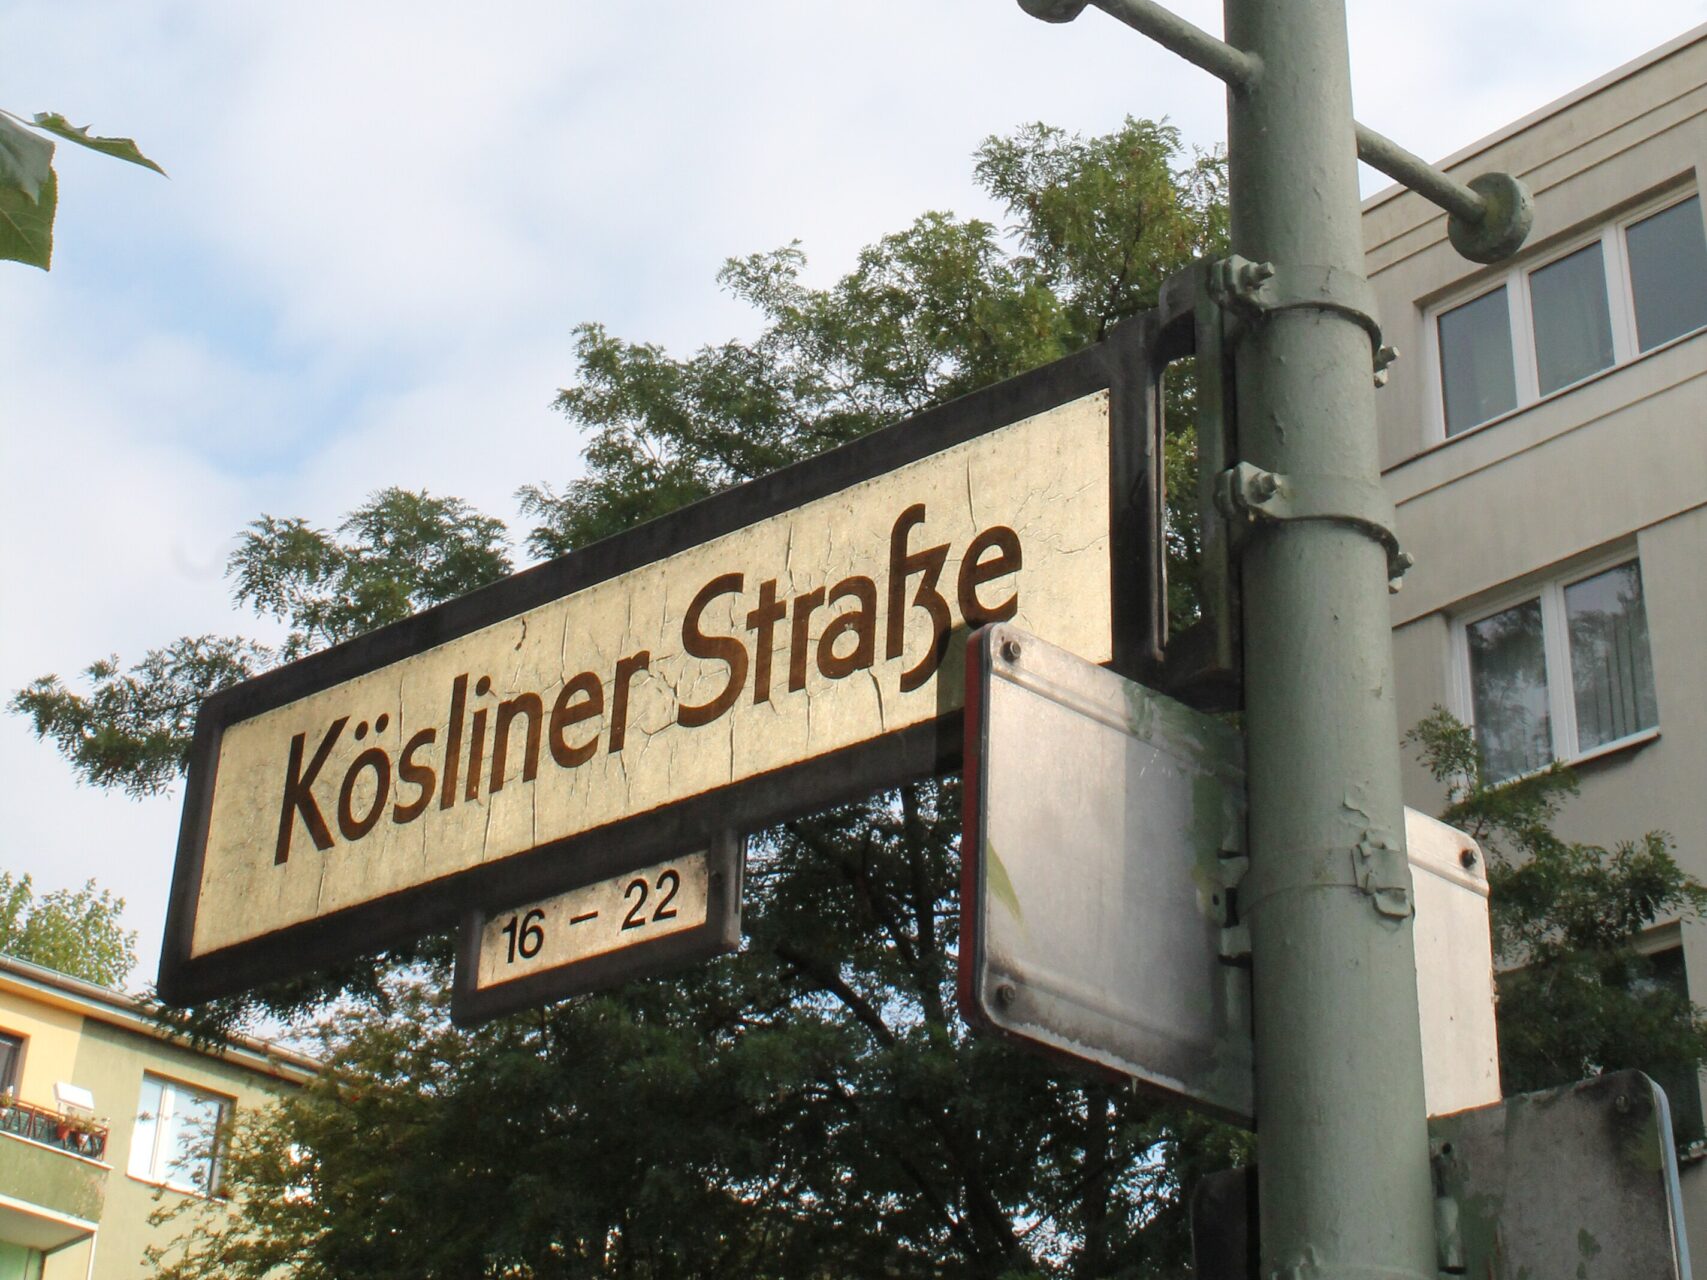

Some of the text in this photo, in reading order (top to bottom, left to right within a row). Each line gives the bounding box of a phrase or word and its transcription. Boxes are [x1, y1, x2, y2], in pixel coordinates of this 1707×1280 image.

[274, 502, 1023, 865] Kösliner Straße
[501, 908, 544, 964] 16
[621, 869, 681, 930] 22
